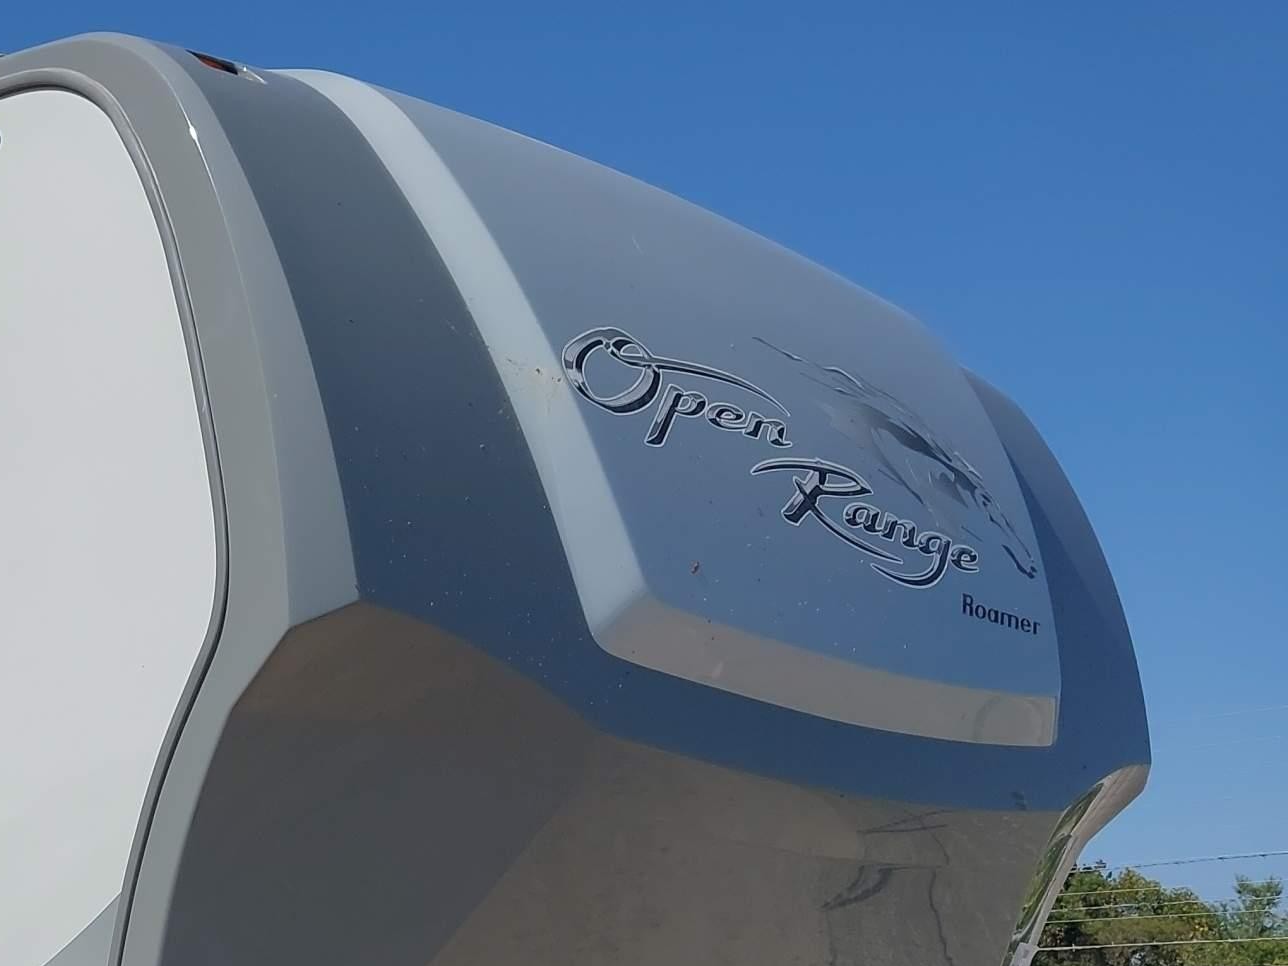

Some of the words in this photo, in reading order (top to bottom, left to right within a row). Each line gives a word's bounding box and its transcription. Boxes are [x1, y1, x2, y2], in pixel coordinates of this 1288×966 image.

[561, 326, 792, 447] Open
[751, 457, 979, 588] Range
[961, 592, 1041, 635] Roamer
